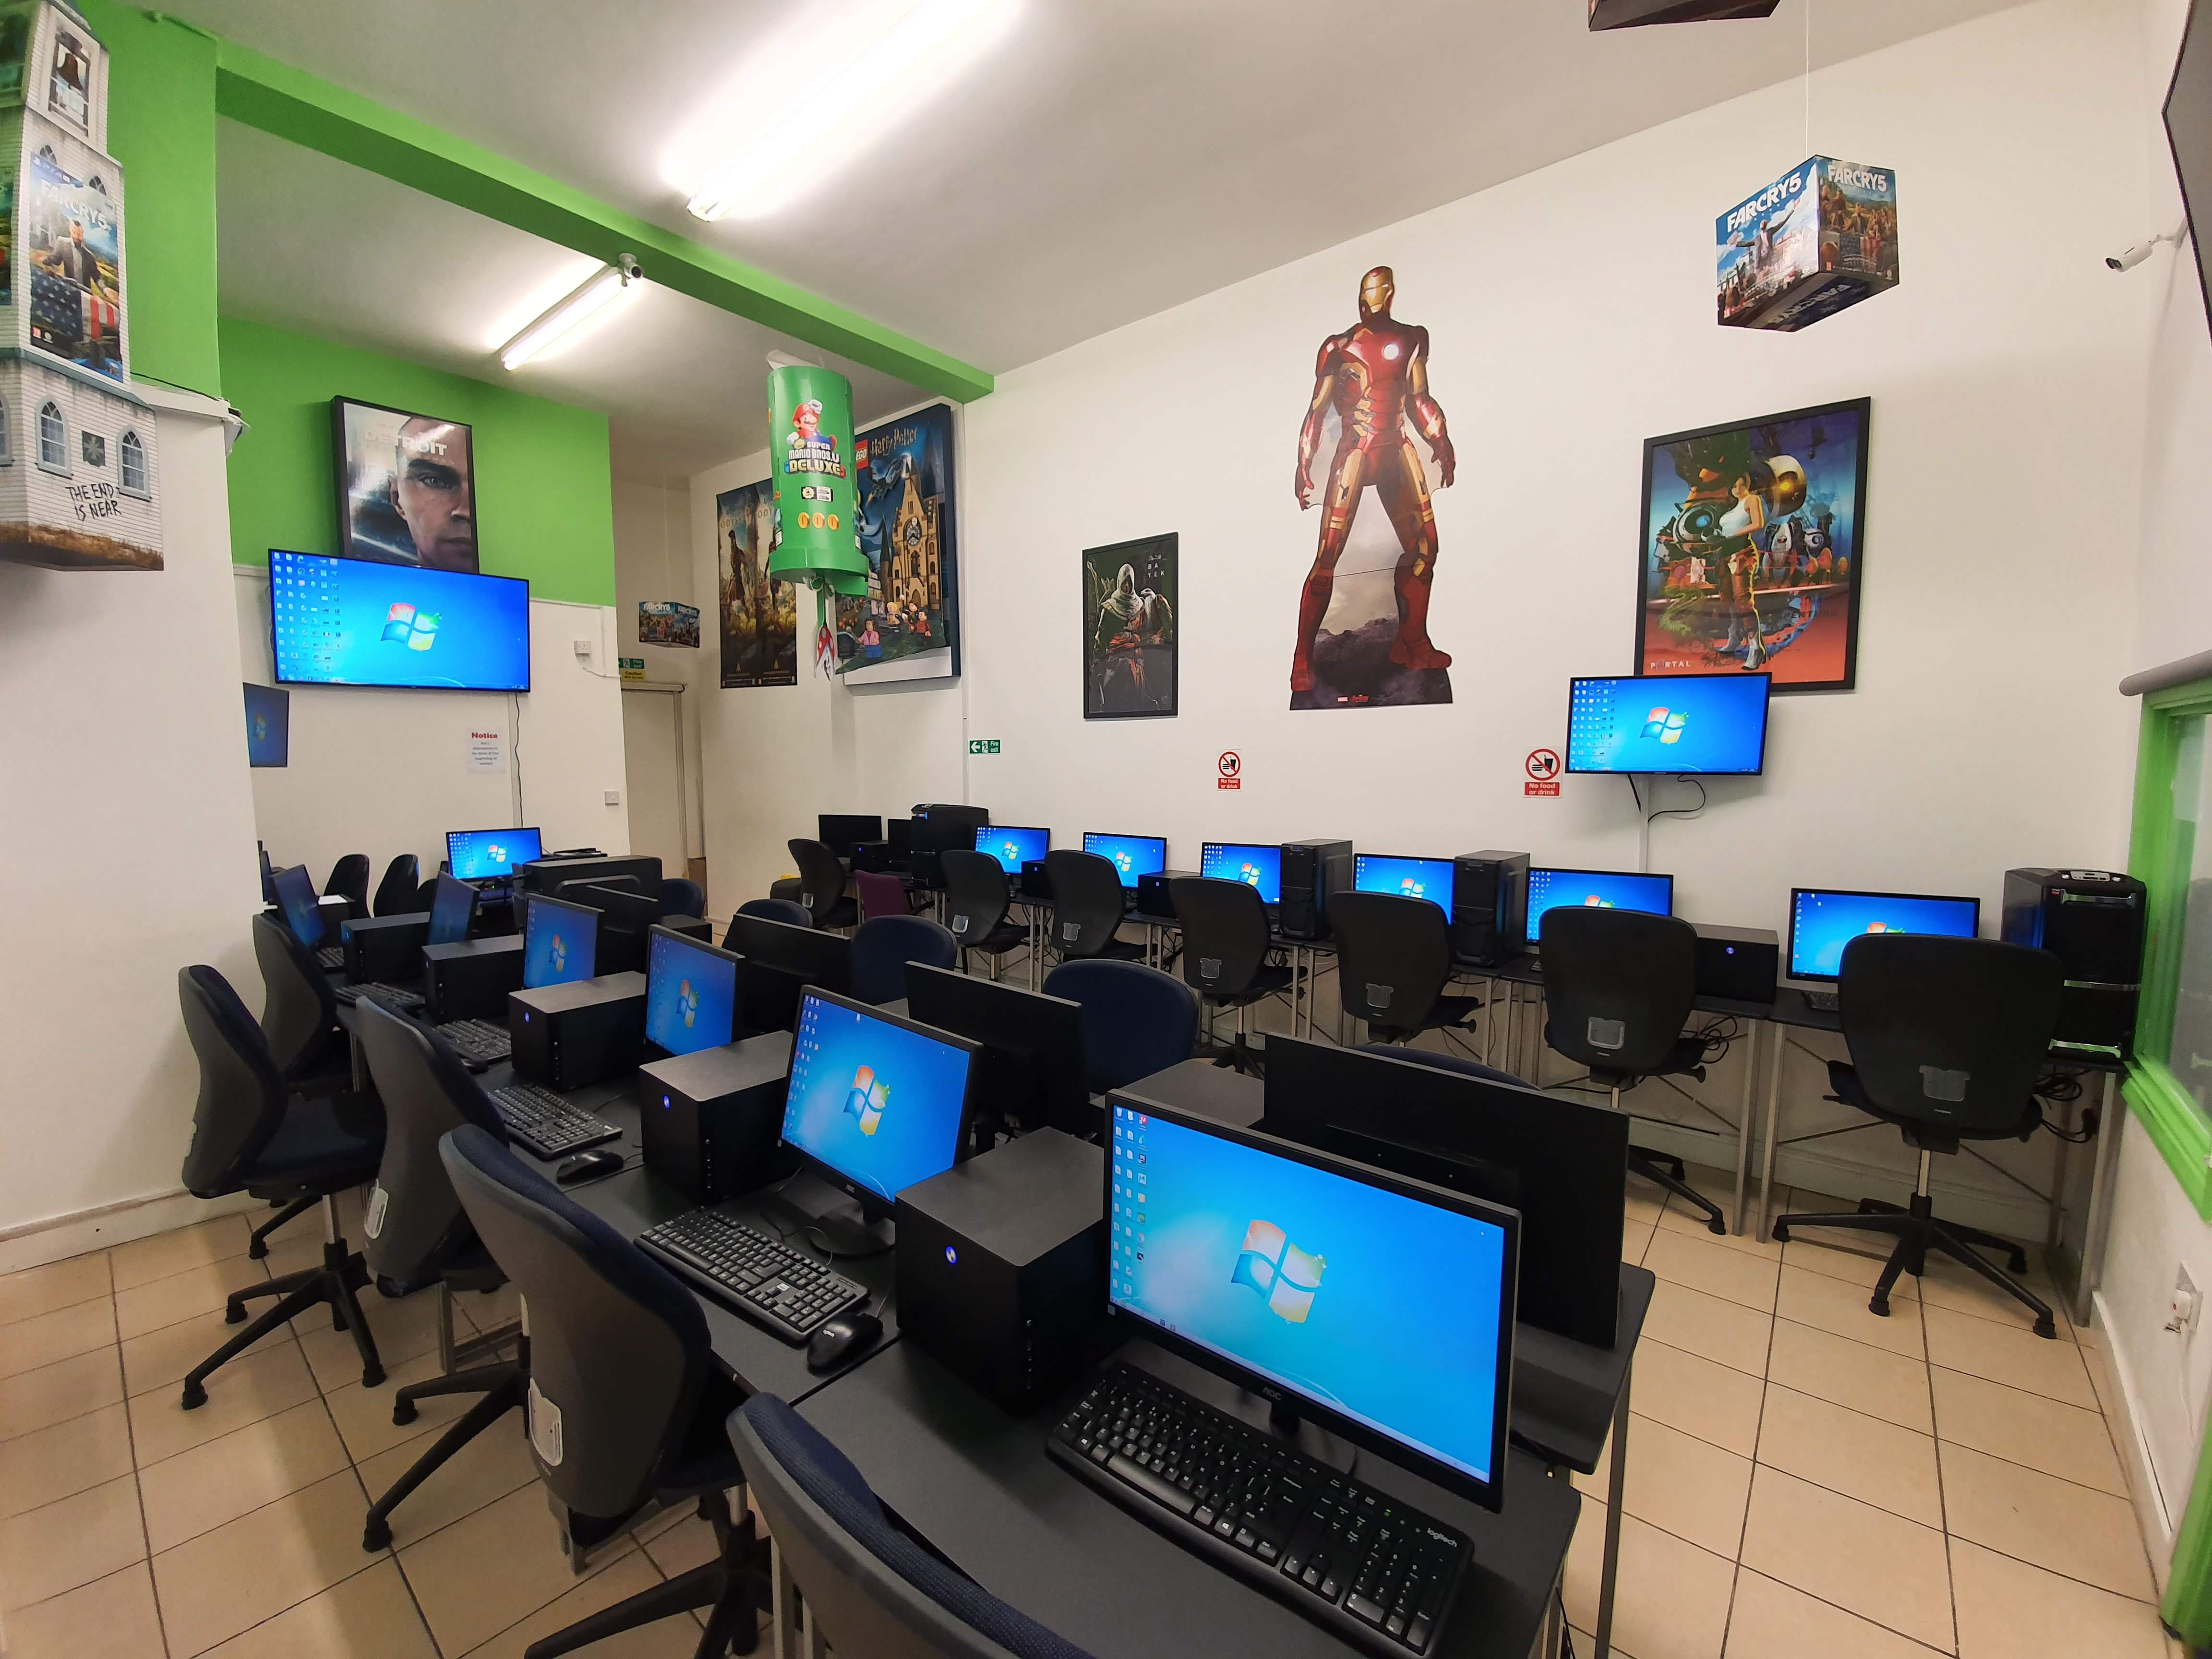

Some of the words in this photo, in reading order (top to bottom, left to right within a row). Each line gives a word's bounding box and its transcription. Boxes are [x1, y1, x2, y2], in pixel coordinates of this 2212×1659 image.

[806, 441, 830, 450] SUPER
[870, 436, 893, 456] Harry
[893, 427, 918, 450] Potter
[789, 448, 811, 460] MARIO
[855, 448, 867, 461] EGO
[789, 459, 841, 475] DELUXE
[65, 486, 89, 502] THE
[91, 482, 114, 499] END
[74, 505, 86, 522] IS
[89, 500, 121, 520] NEAR
[1650, 659, 1691, 672] PORTAL
[1427, 1527, 1458, 1548] logitech
